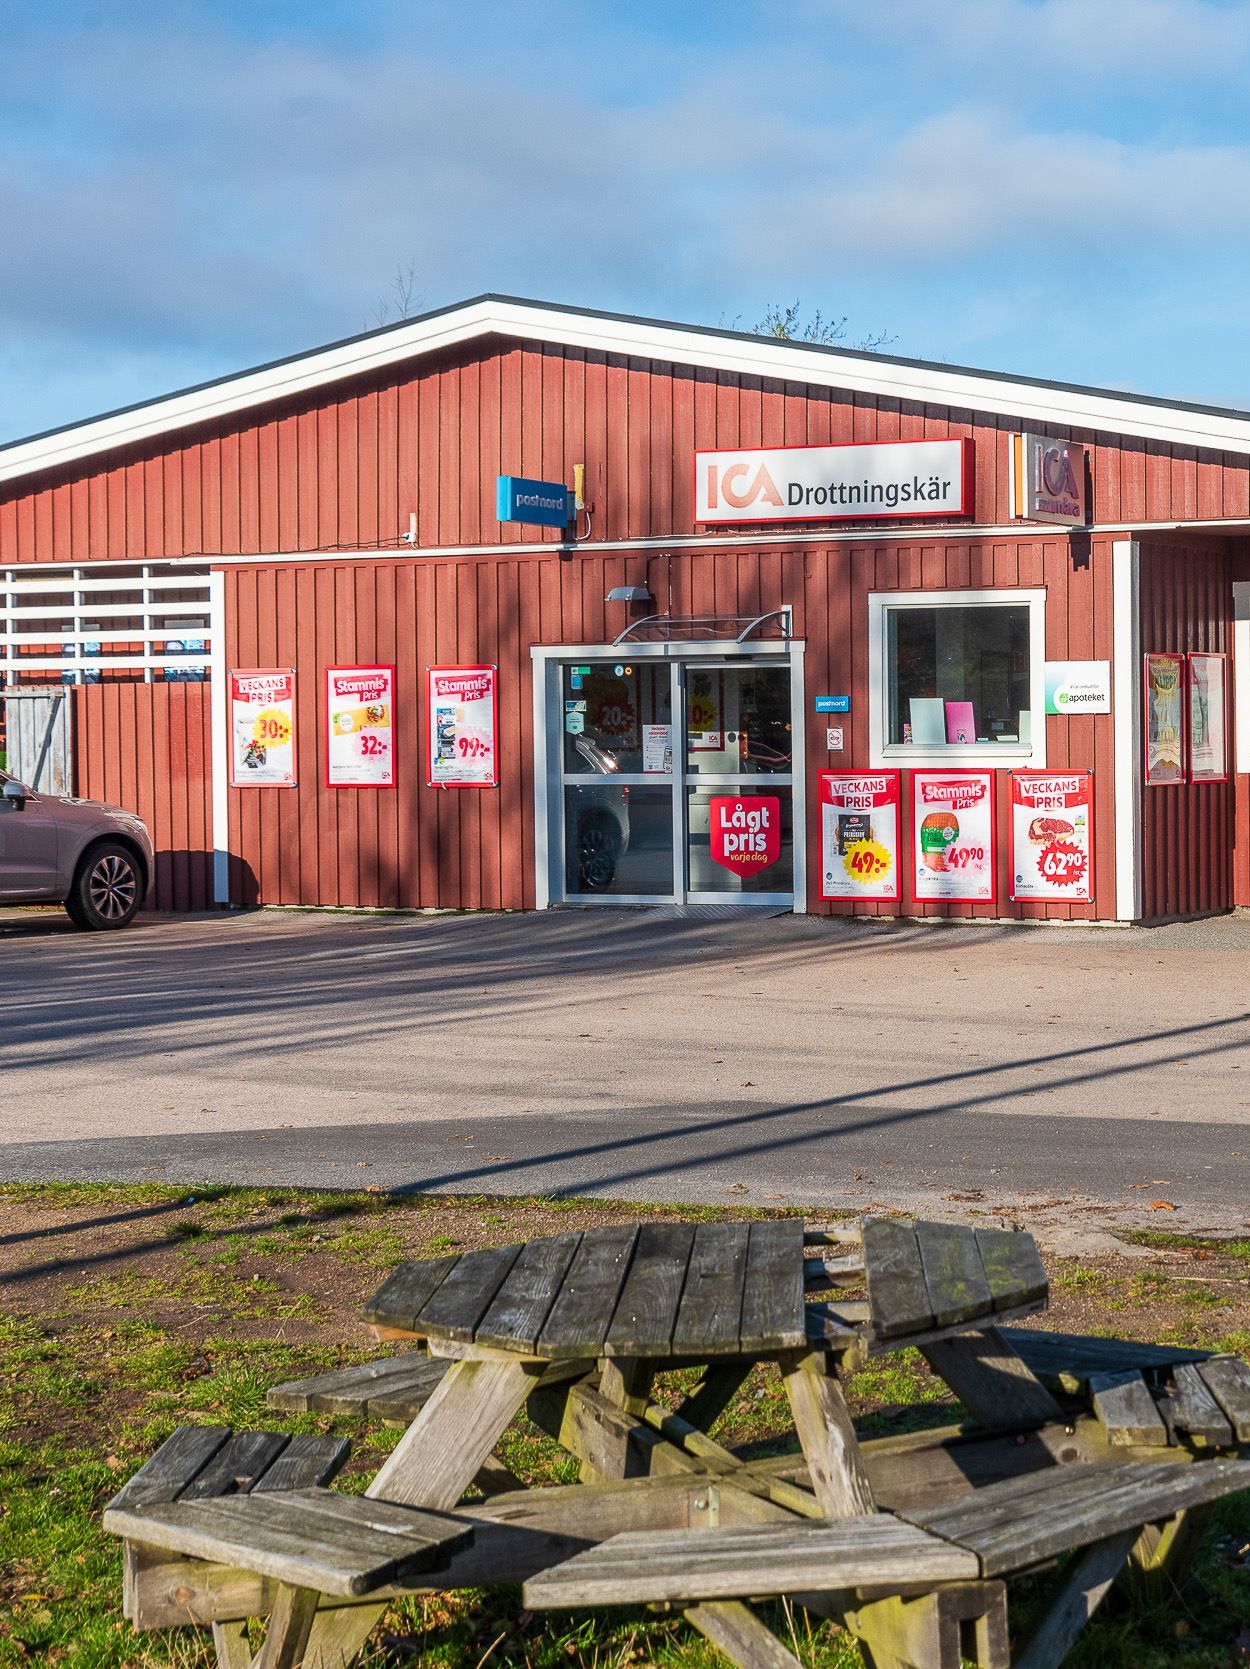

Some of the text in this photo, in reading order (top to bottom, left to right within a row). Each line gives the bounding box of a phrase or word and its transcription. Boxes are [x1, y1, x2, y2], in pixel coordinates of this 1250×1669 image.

[1035, 444, 1079, 499] ICA
[707, 462, 951, 509] ICA Drottningskär
[516, 494, 564, 510] postnord
[240, 678, 284, 691] VECKANS
[336, 676, 385, 693] Stammis
[437, 676, 488, 693] Stammis
[251, 692, 273, 703] PRIS
[817, 700, 846, 708] postnord
[1068, 693, 1105, 703] apoteket
[360, 735, 388, 756] 32:-
[459, 737, 490, 758] 99:-
[833, 780, 885, 795] VECKANS
[925, 782, 982, 800] Stammis
[1023, 780, 1077, 795] VECKANS
[845, 796, 872, 808] PRIS
[1036, 796, 1063, 808] PRIS
[720, 803, 770, 833] Lågt
[723, 827, 767, 857] pris
[730, 851, 768, 864] varje dag
[851, 851, 887, 873] 49:-
